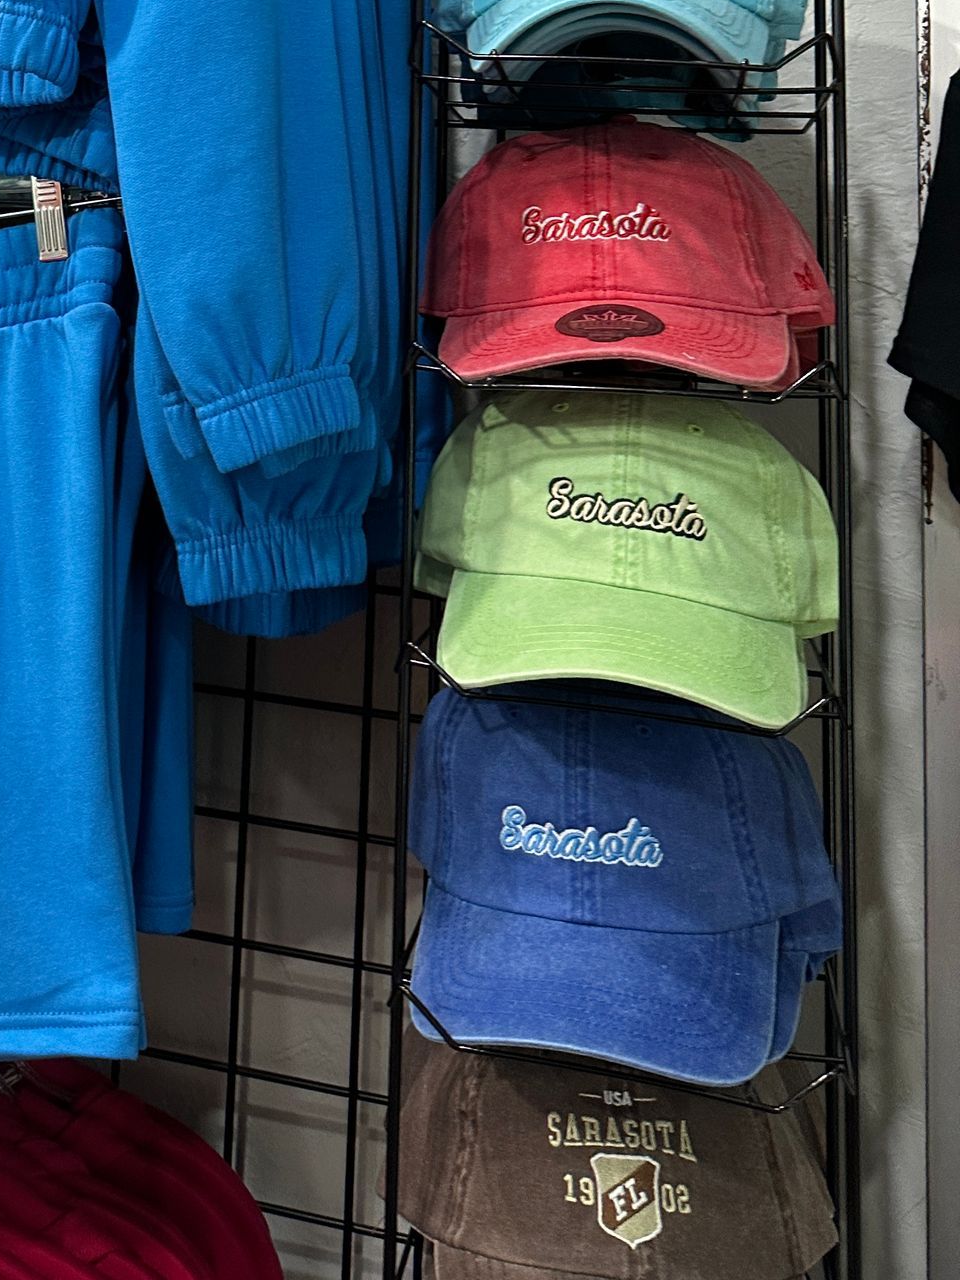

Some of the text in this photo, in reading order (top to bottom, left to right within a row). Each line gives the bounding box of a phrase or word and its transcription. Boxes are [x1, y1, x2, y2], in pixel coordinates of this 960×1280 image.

[522, 203, 672, 245] Sarasota
[546, 477, 708, 541] Sarasota
[499, 805, 664, 868] Sarasota
[603, 1090, 632, 1106] USA
[547, 1112, 697, 1163] SARASOTA
[563, 1173, 691, 1213] 19 02
[608, 1178, 648, 1221] FL
